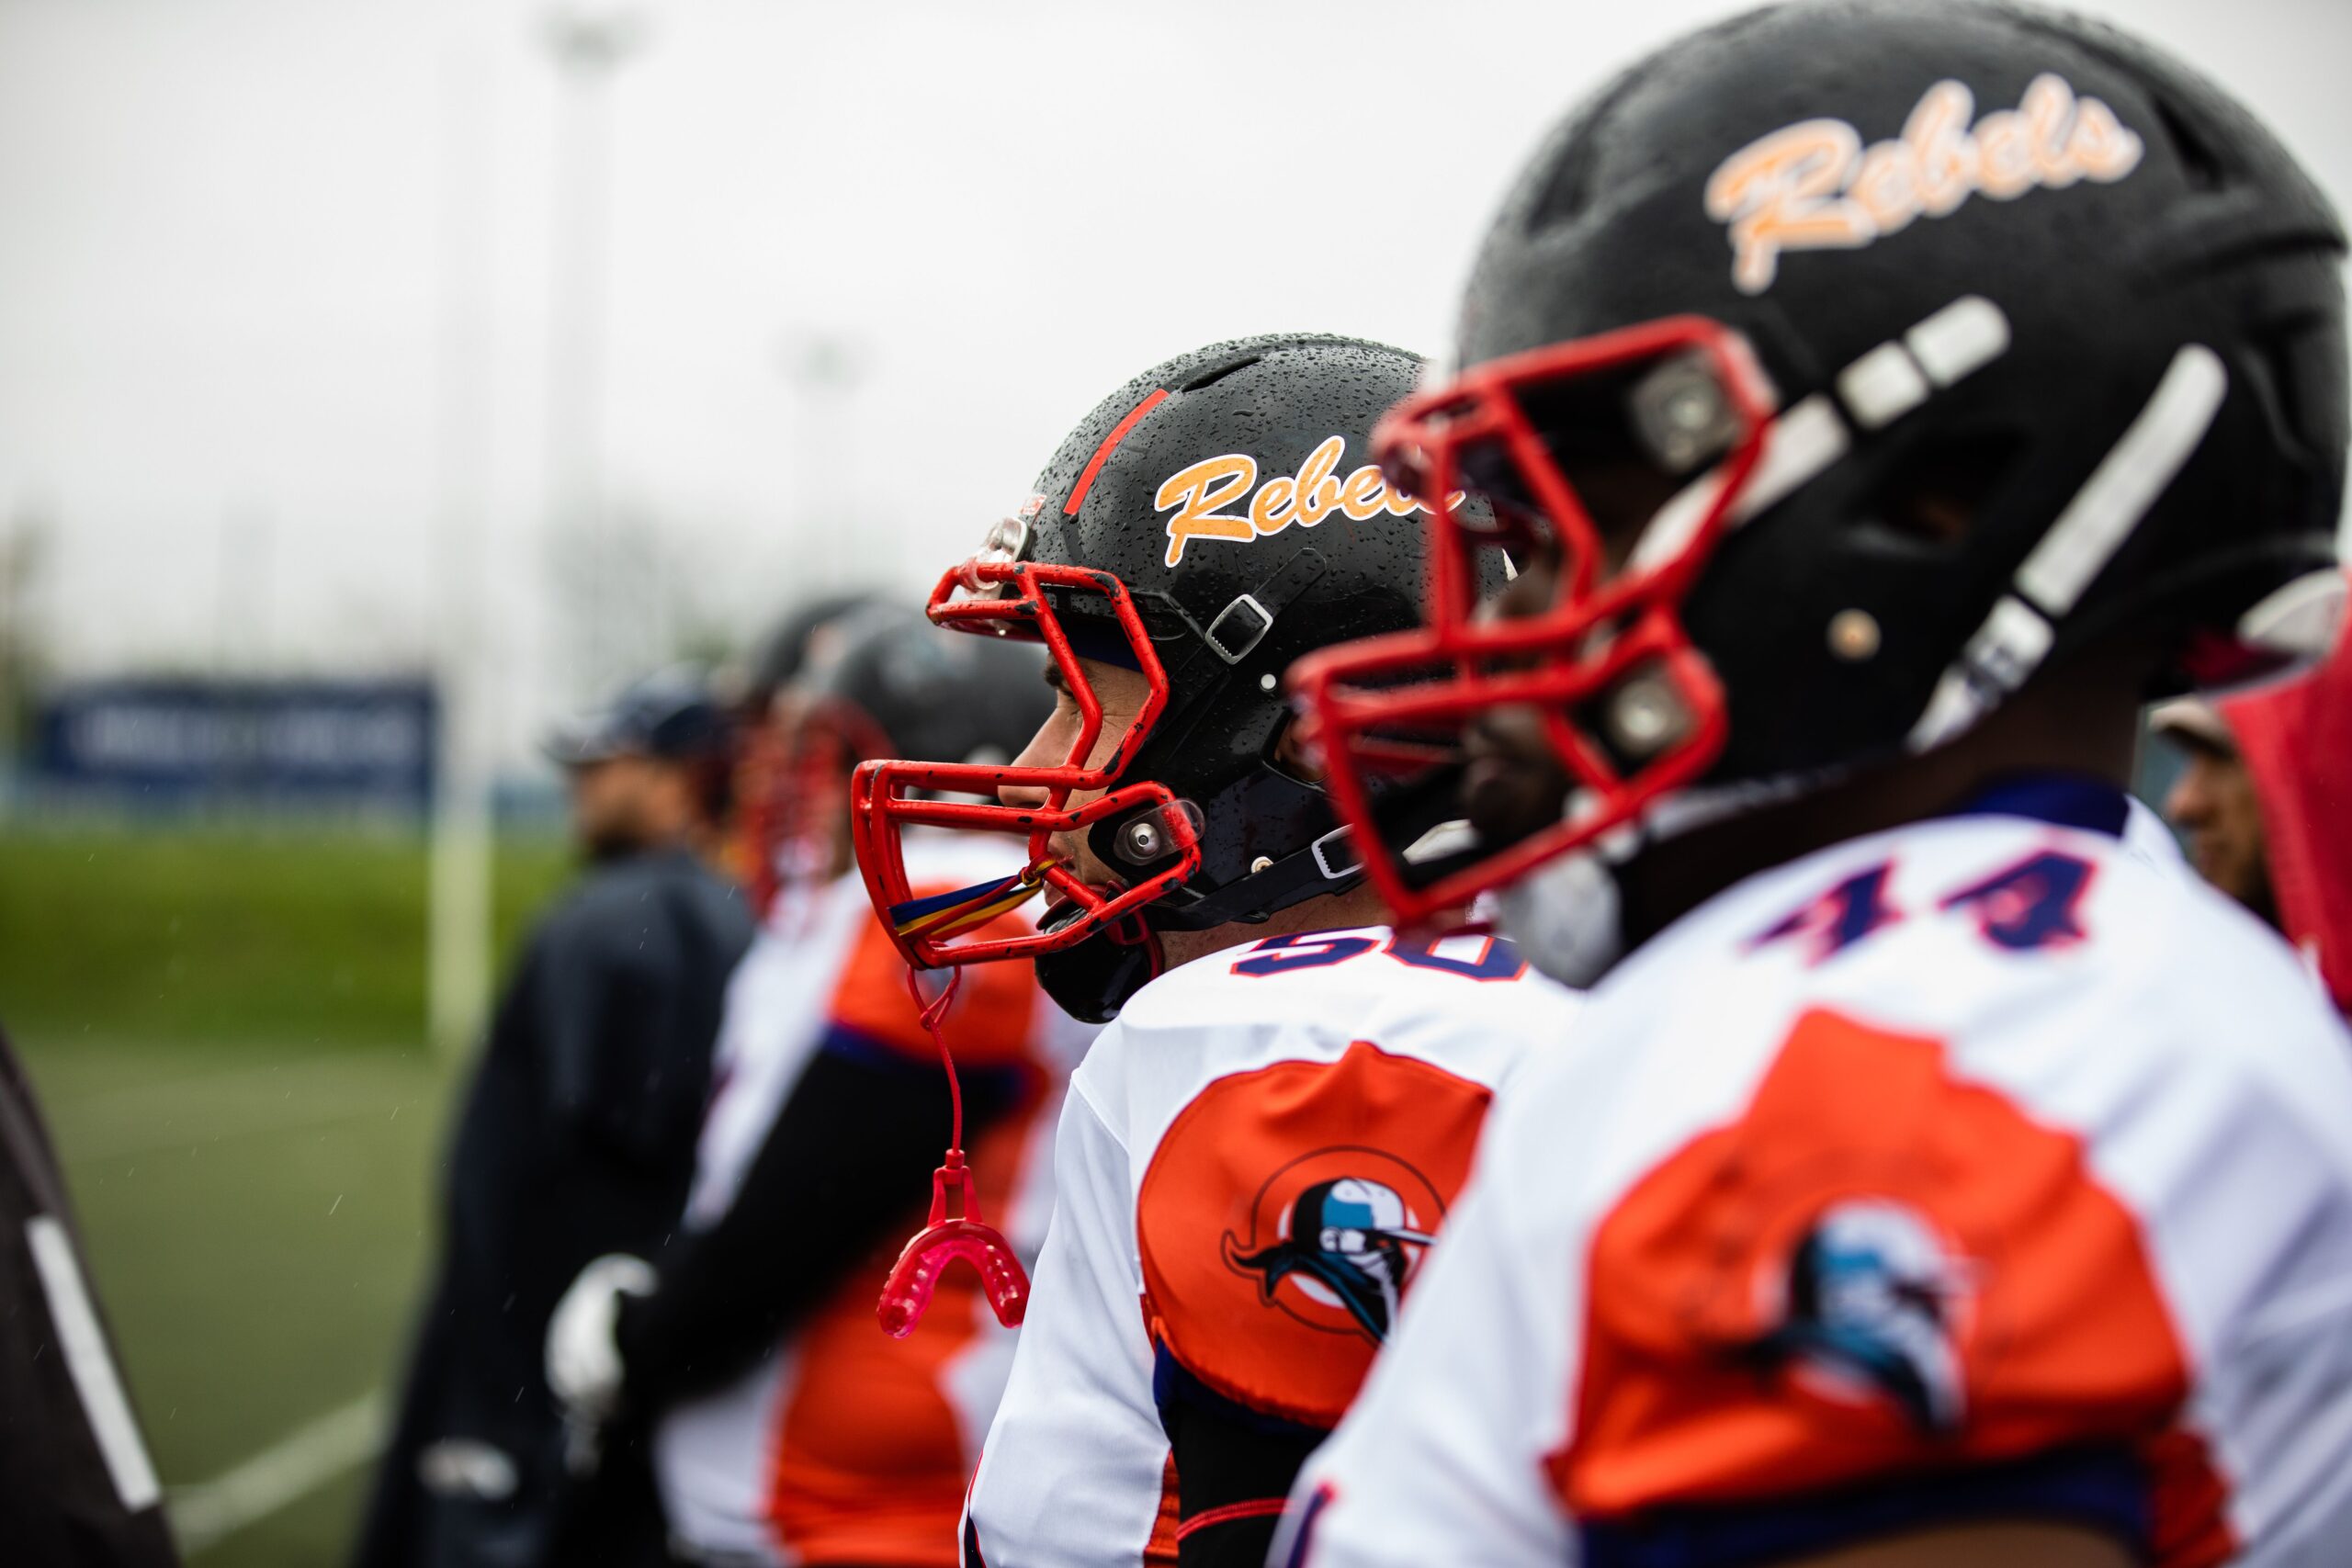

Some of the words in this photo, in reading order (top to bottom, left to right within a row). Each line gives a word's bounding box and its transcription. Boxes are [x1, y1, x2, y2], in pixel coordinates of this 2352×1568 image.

[1704, 73, 2144, 295] Rebels
[1155, 435, 1466, 568] Rebe
[1738, 847, 2098, 970] 44
